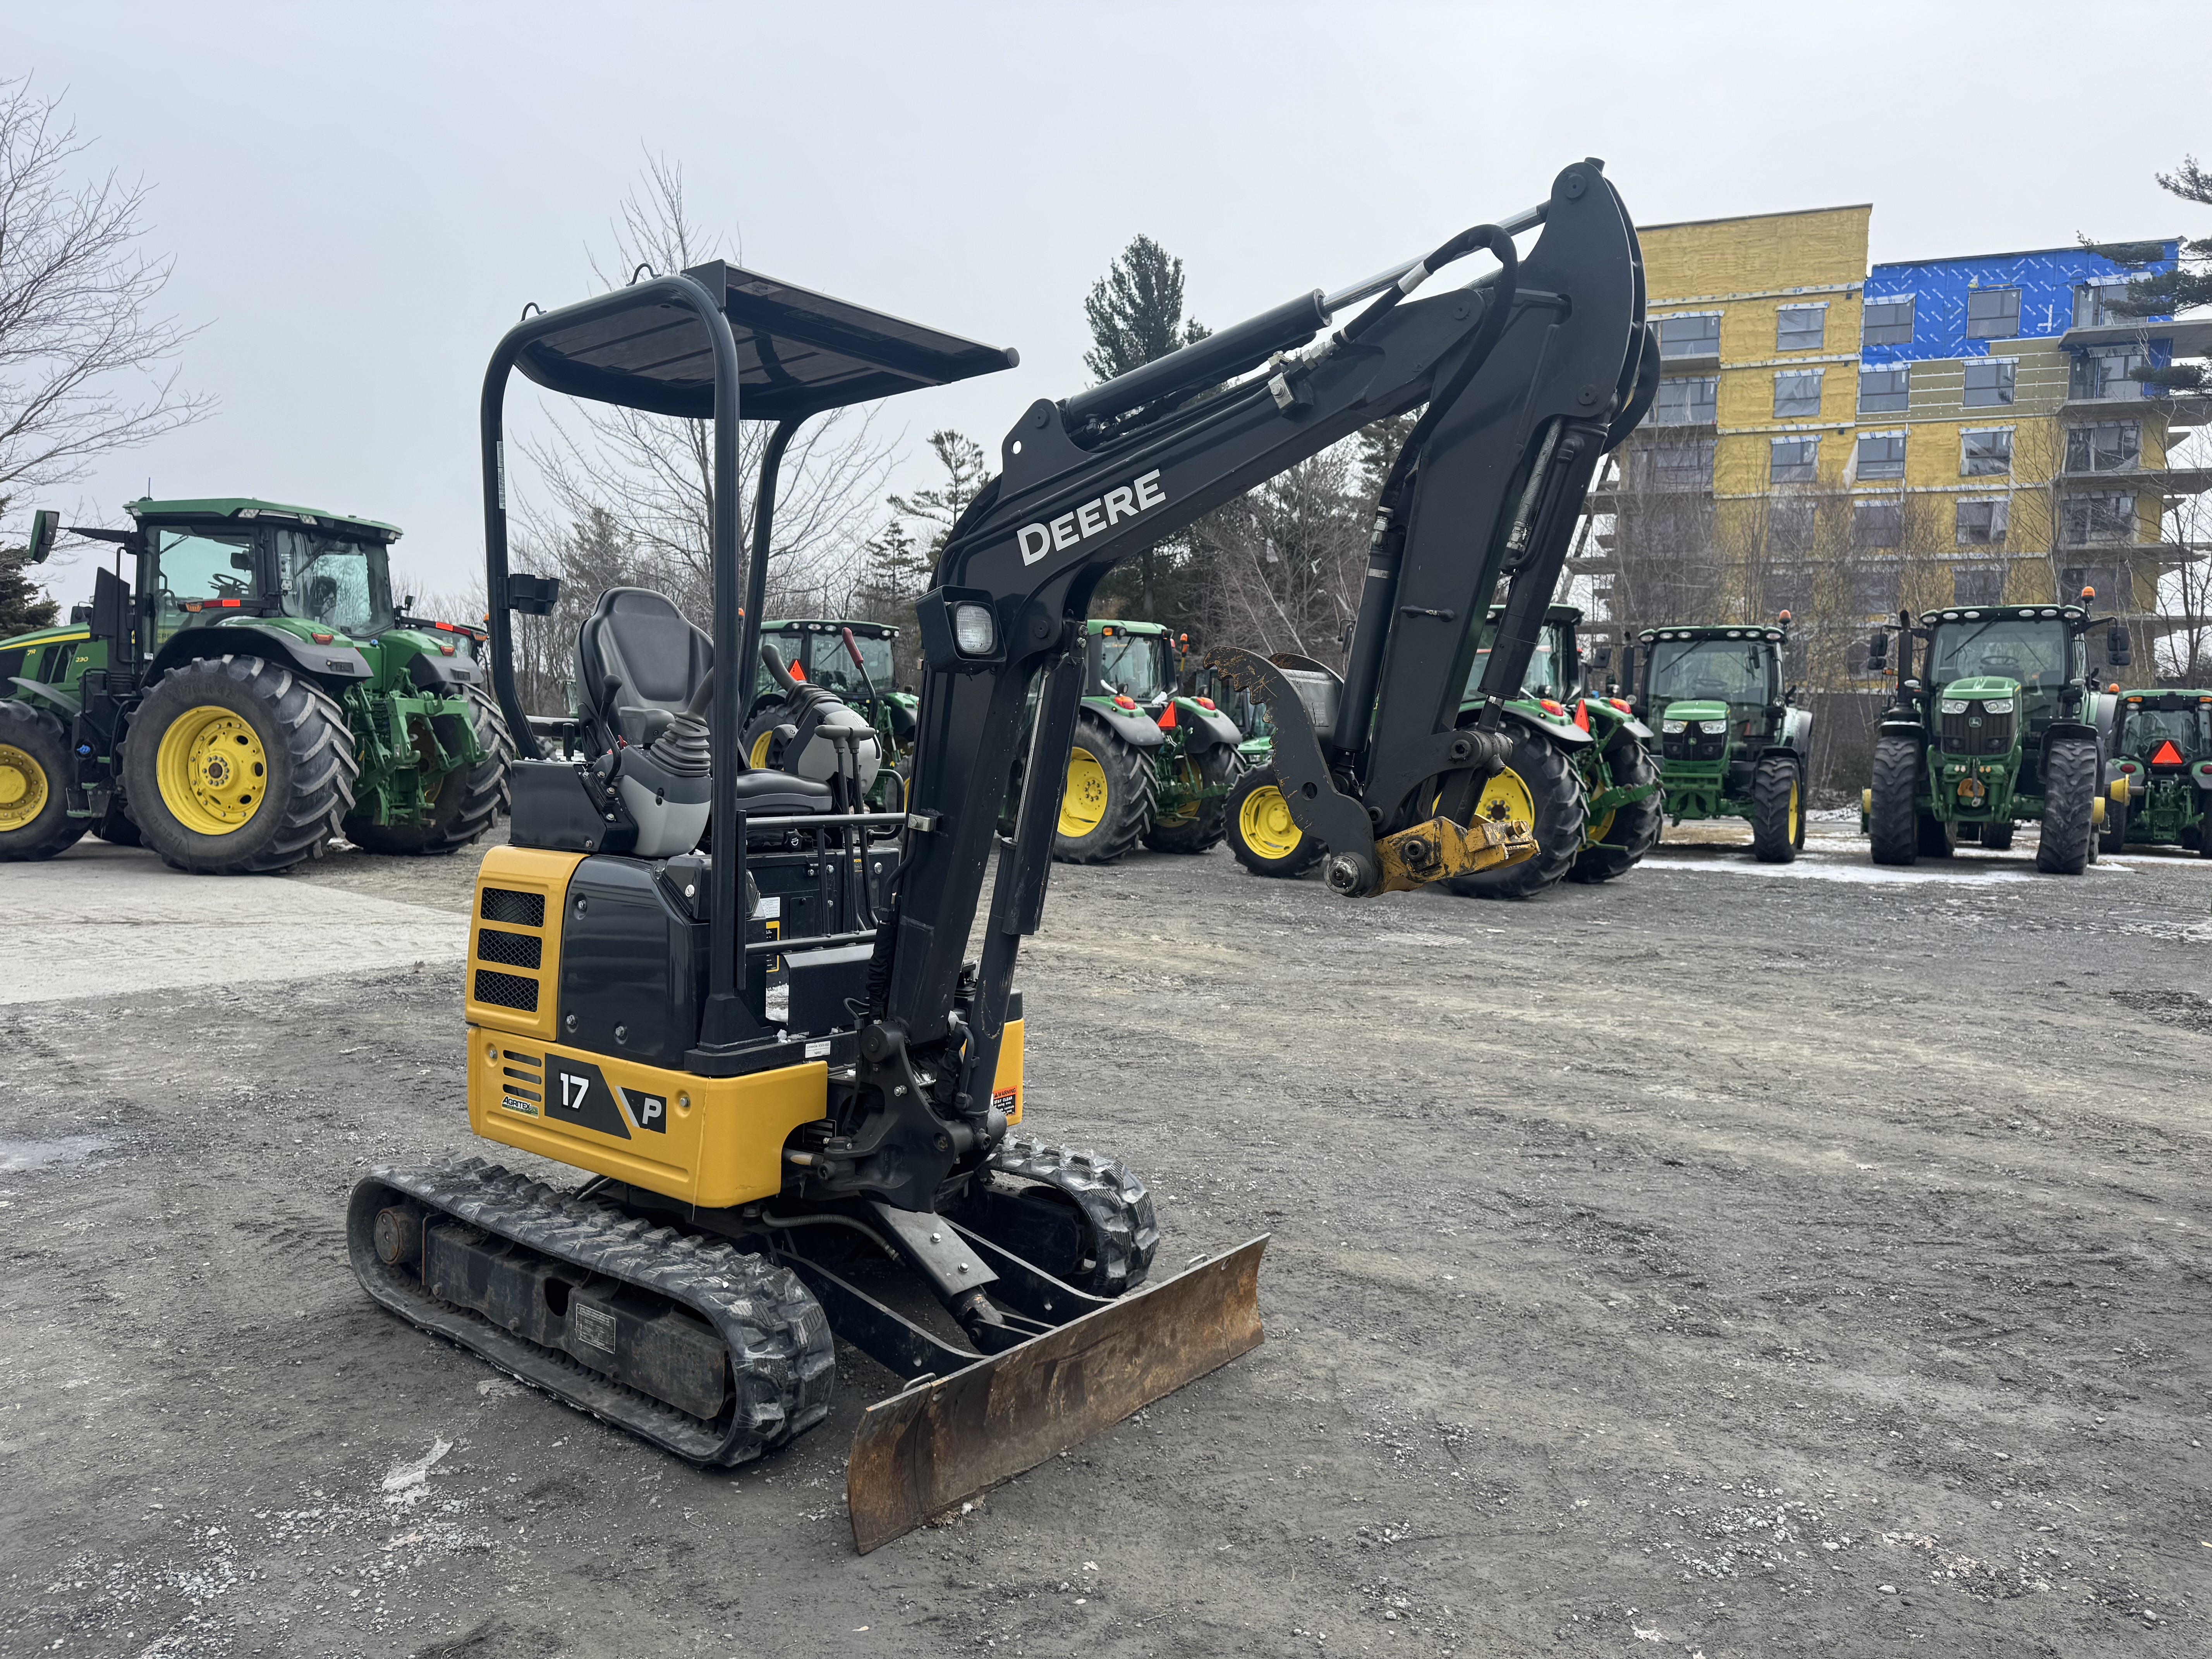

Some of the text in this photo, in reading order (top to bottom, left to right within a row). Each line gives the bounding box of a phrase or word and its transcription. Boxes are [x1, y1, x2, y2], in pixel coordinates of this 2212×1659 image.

[1017, 469, 1166, 566] DEERE
[502, 1096, 531, 1109] AGRITEX
[560, 1072, 662, 1125] 17 P
[998, 1088, 1016, 1097] WARNING
